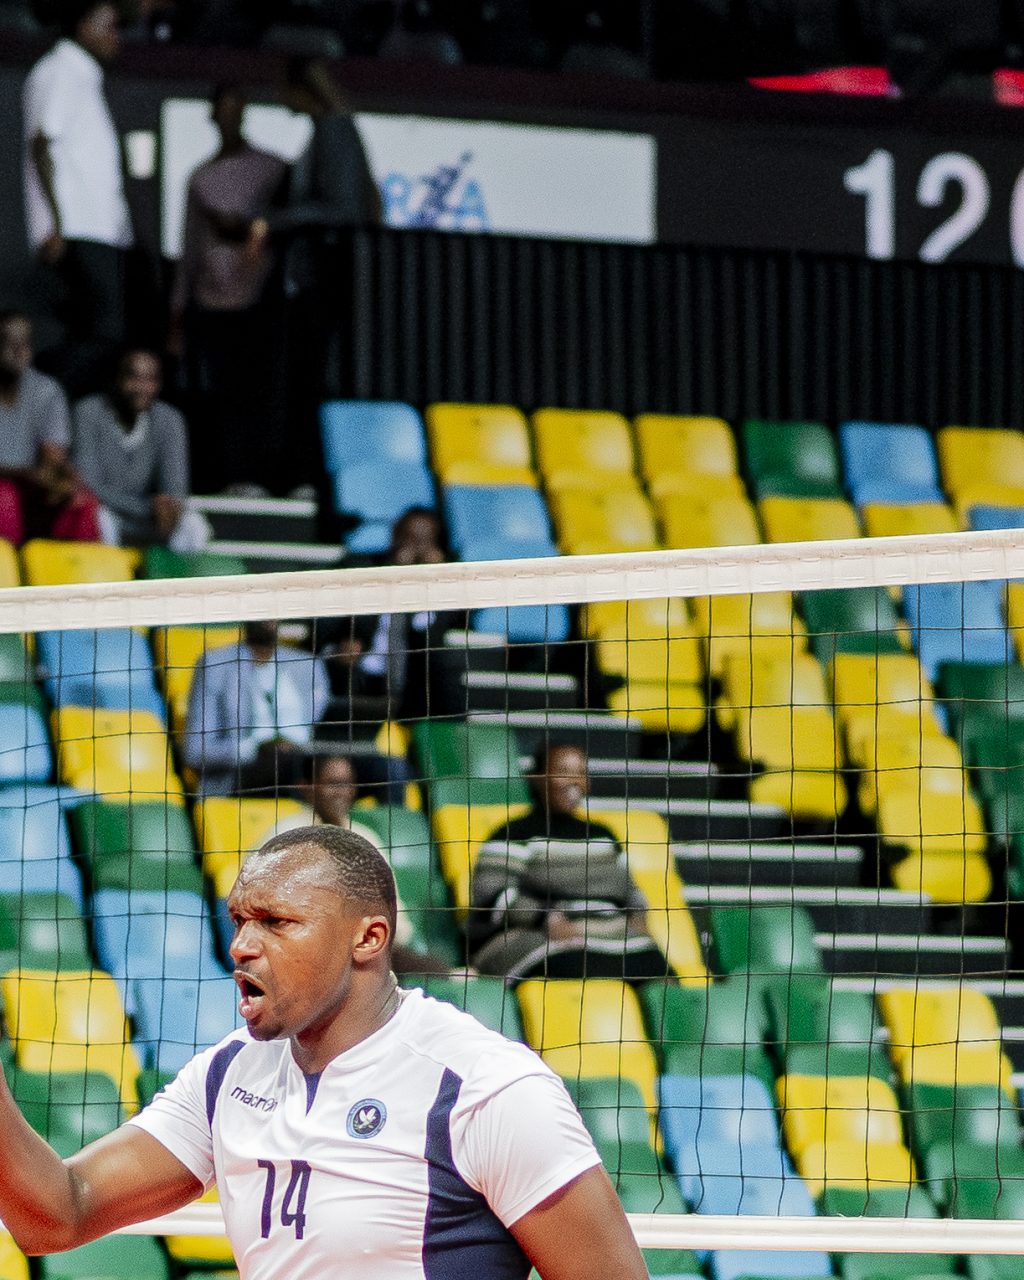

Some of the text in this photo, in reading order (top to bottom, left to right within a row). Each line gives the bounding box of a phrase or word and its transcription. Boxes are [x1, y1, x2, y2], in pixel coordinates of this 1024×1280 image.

[842, 148, 1024, 268] 12
[230, 1086, 278, 1113] macron
[256, 1158, 312, 1240] 14
